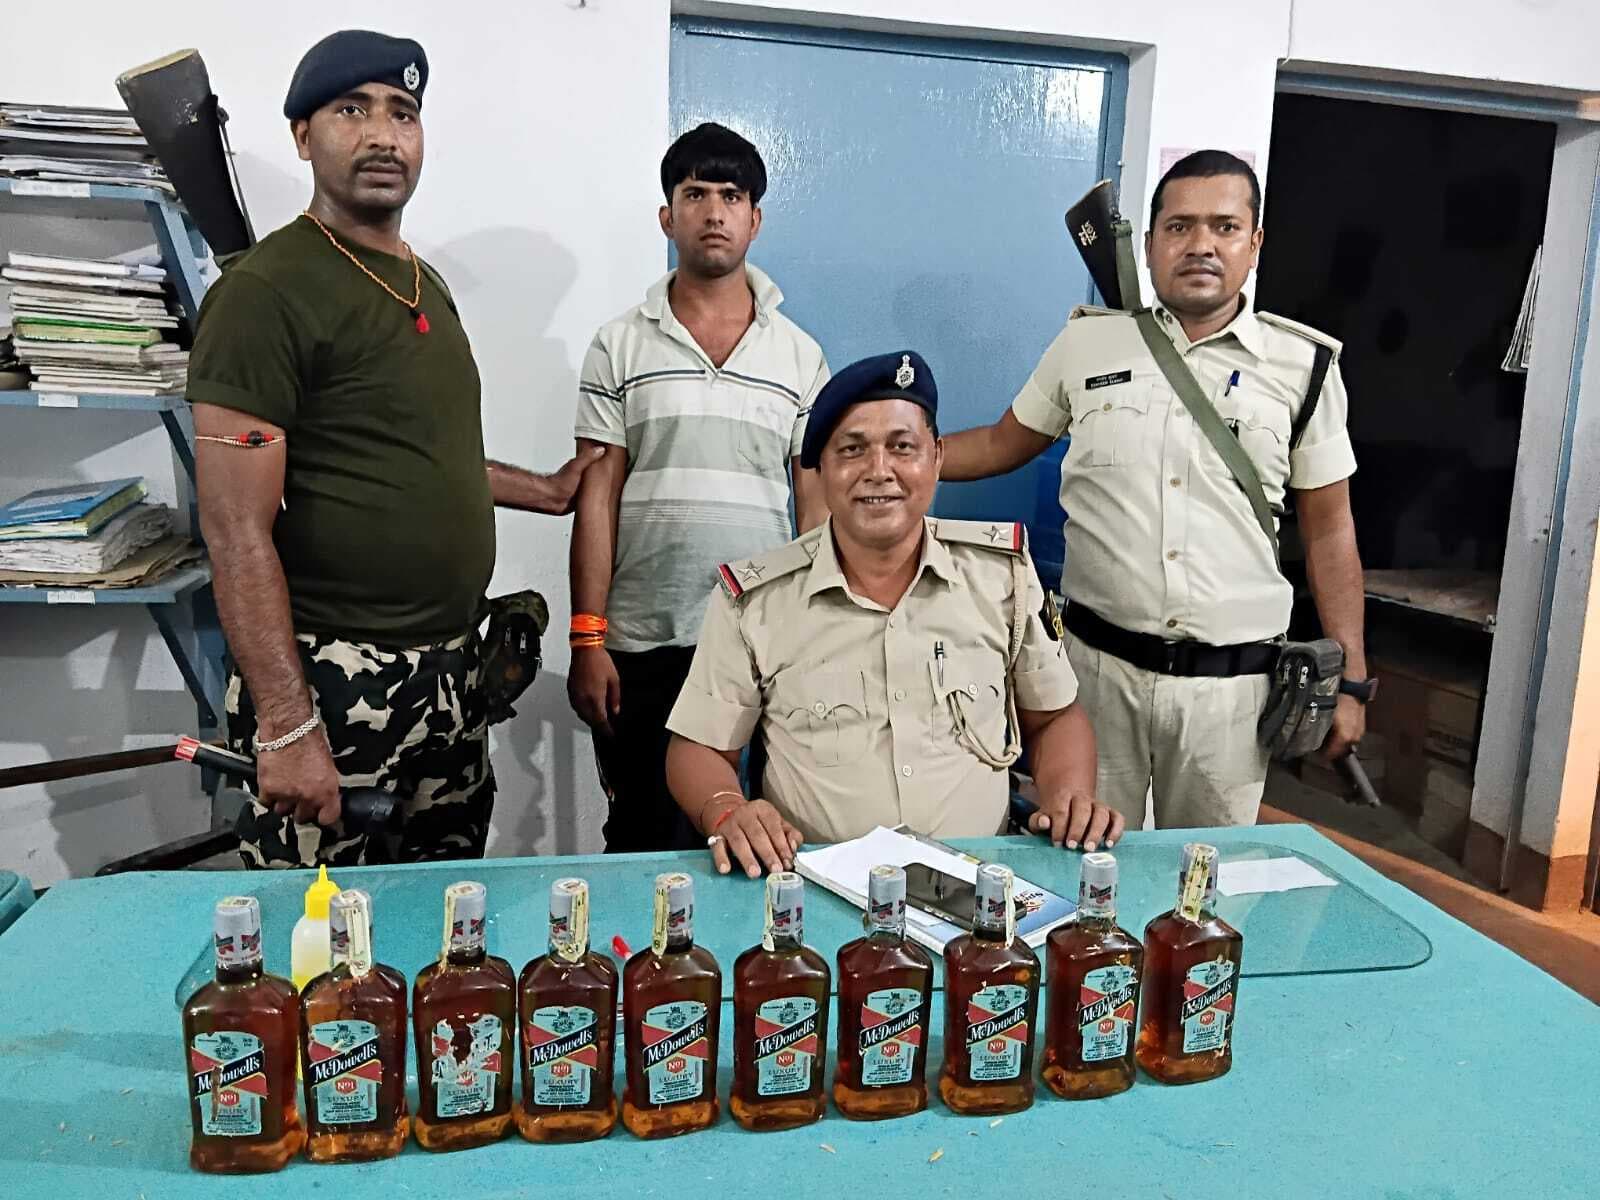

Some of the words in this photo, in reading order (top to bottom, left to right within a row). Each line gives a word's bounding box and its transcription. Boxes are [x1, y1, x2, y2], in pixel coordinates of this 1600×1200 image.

[758, 1018, 815, 1058] McDowell's
[863, 1010, 920, 1047] McDowell's
[971, 1006, 1025, 1041] McDowell's
[532, 1029, 593, 1065] McDowell's
[647, 1022, 704, 1066] McDowell's
[314, 1043, 377, 1083] McDowell's
[327, 1094, 366, 1102] LUXURY
